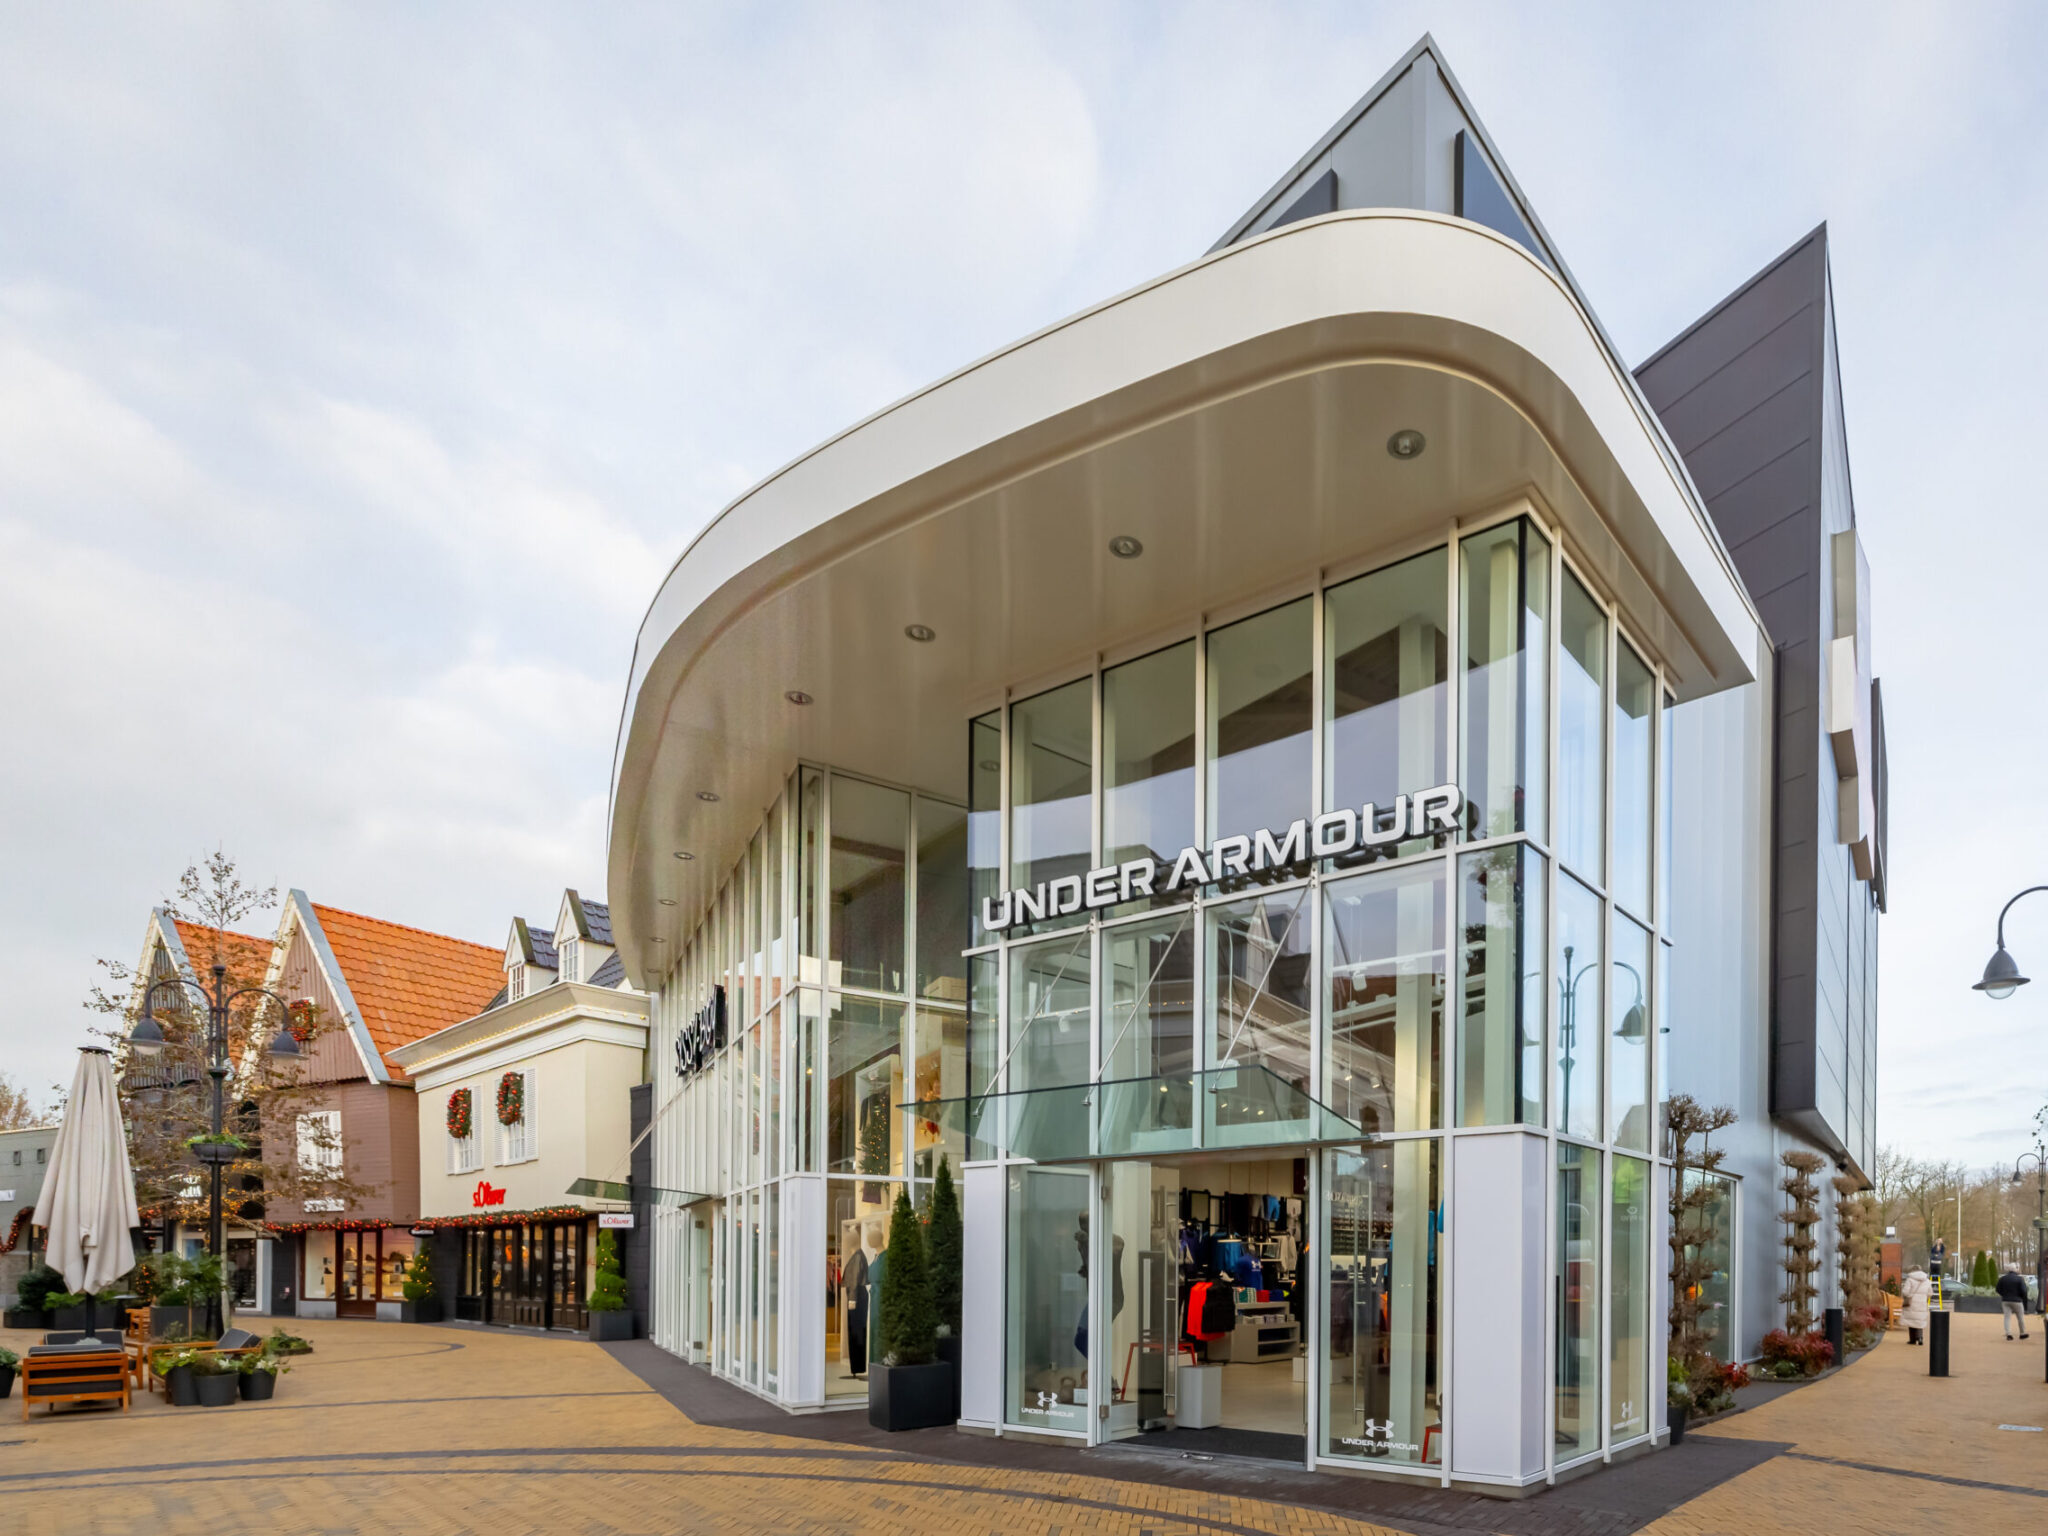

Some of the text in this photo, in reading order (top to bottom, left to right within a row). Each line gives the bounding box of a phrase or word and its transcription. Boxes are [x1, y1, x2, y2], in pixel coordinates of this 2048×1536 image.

[981, 783, 1463, 931] UNDER ARMOUR
[1341, 1437, 1419, 1451] UNDER ARMOUR
